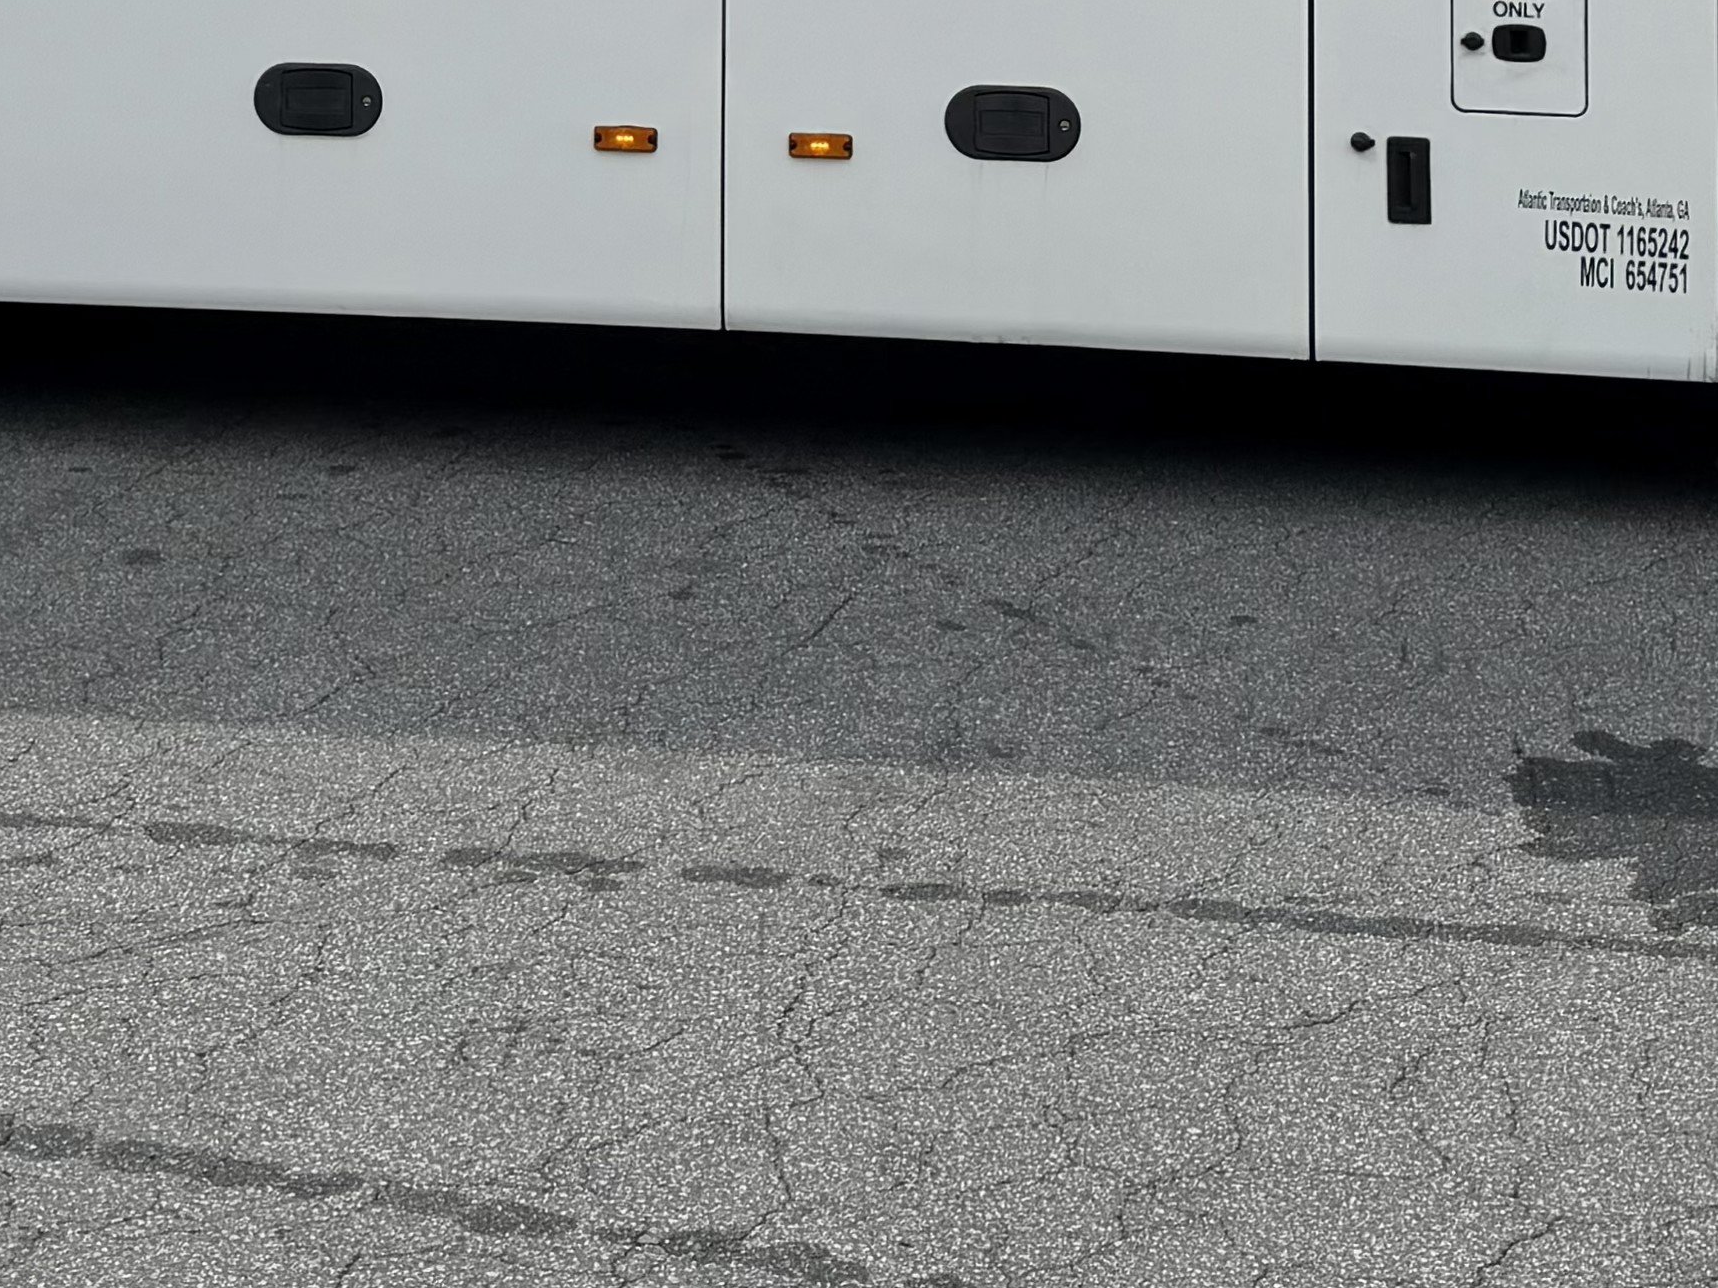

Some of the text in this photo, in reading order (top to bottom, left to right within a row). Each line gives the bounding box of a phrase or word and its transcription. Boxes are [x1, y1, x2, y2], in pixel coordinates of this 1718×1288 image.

[1493, 0, 1545, 18] ONLY
[1517, 188, 1547, 210] Atlantic
[1603, 194, 1610, 215] &
[1677, 199, 1690, 221] GA
[1544, 219, 1690, 261] USDOT 1165242
[1580, 255, 1687, 294] MCI 654751
